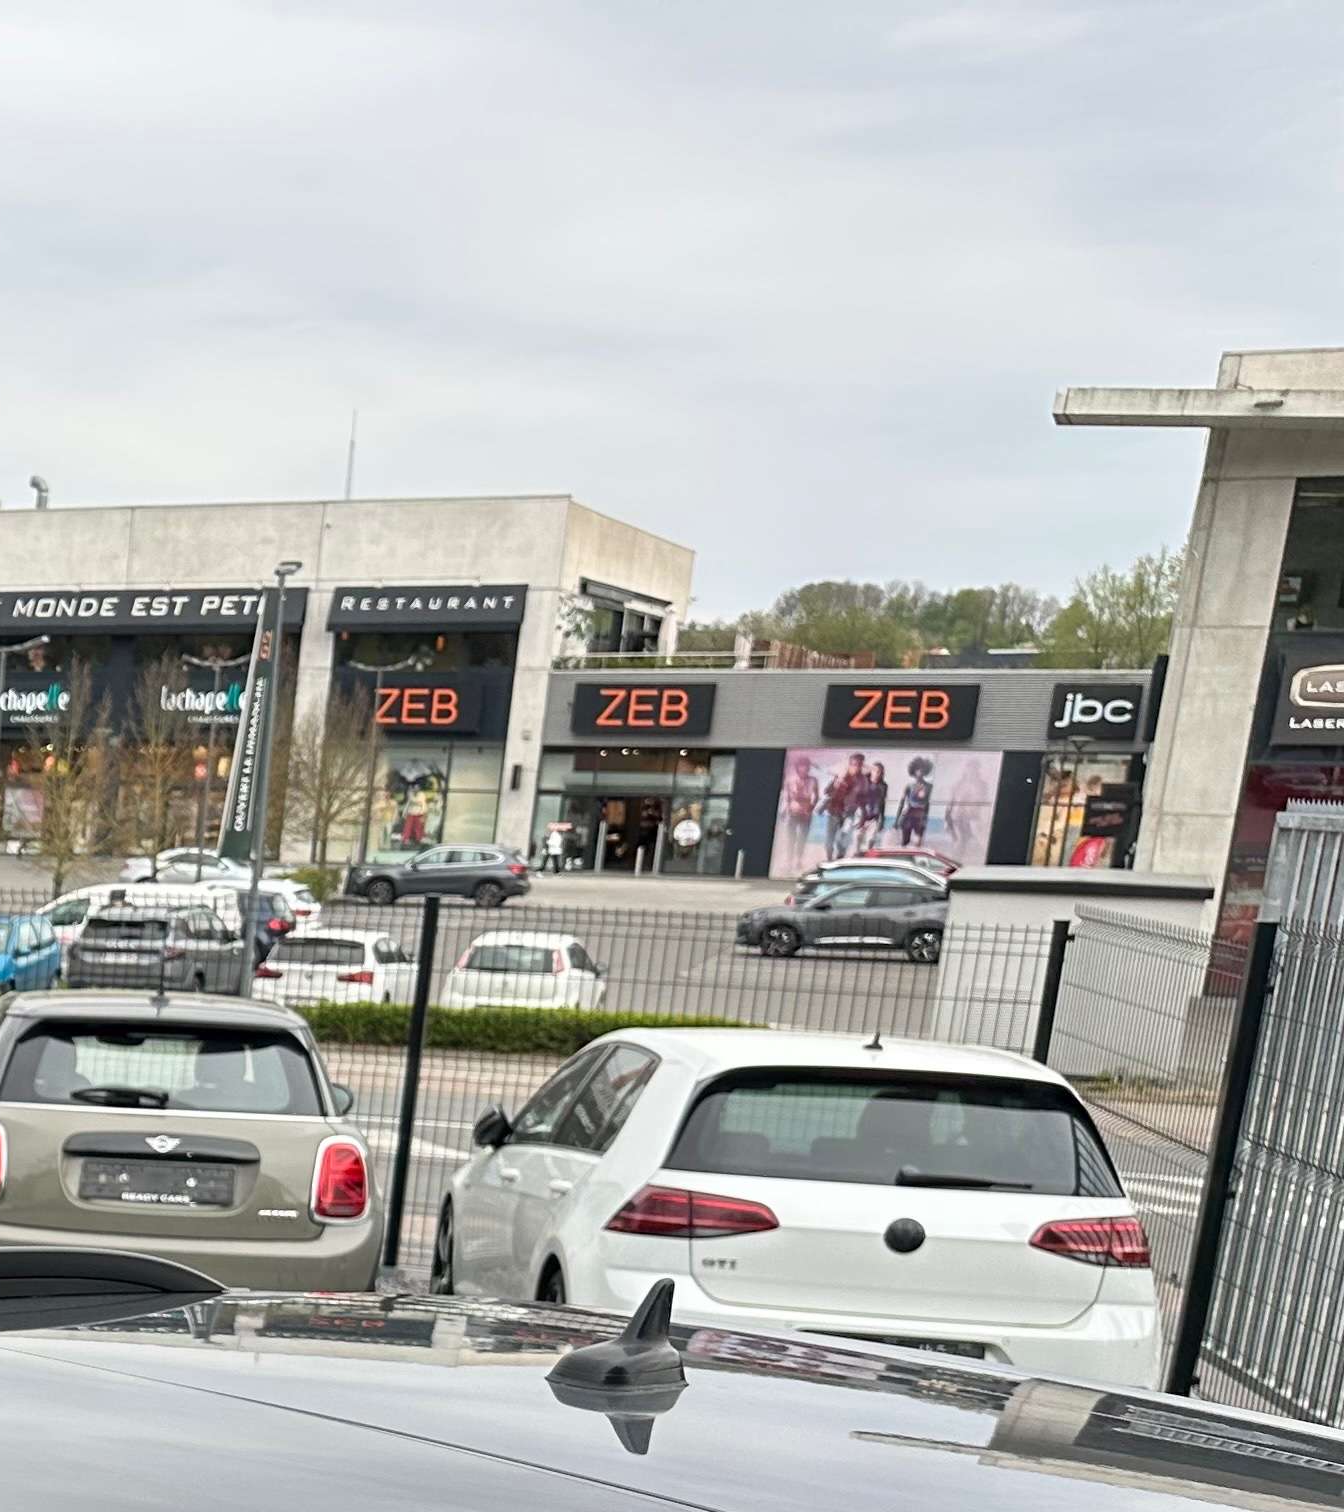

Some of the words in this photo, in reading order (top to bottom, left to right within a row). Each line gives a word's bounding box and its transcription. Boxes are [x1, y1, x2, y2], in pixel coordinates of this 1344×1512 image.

[12, 597, 116, 618] MONDE
[131, 596, 189, 617] EST
[200, 595, 265, 616] PETI
[339, 595, 515, 612] RESTAURANT
[375, 687, 459, 725] ZEB
[595, 688, 689, 728] ZEB
[848, 689, 950, 730] ZEB
[1054, 692, 1134, 729] jbc
